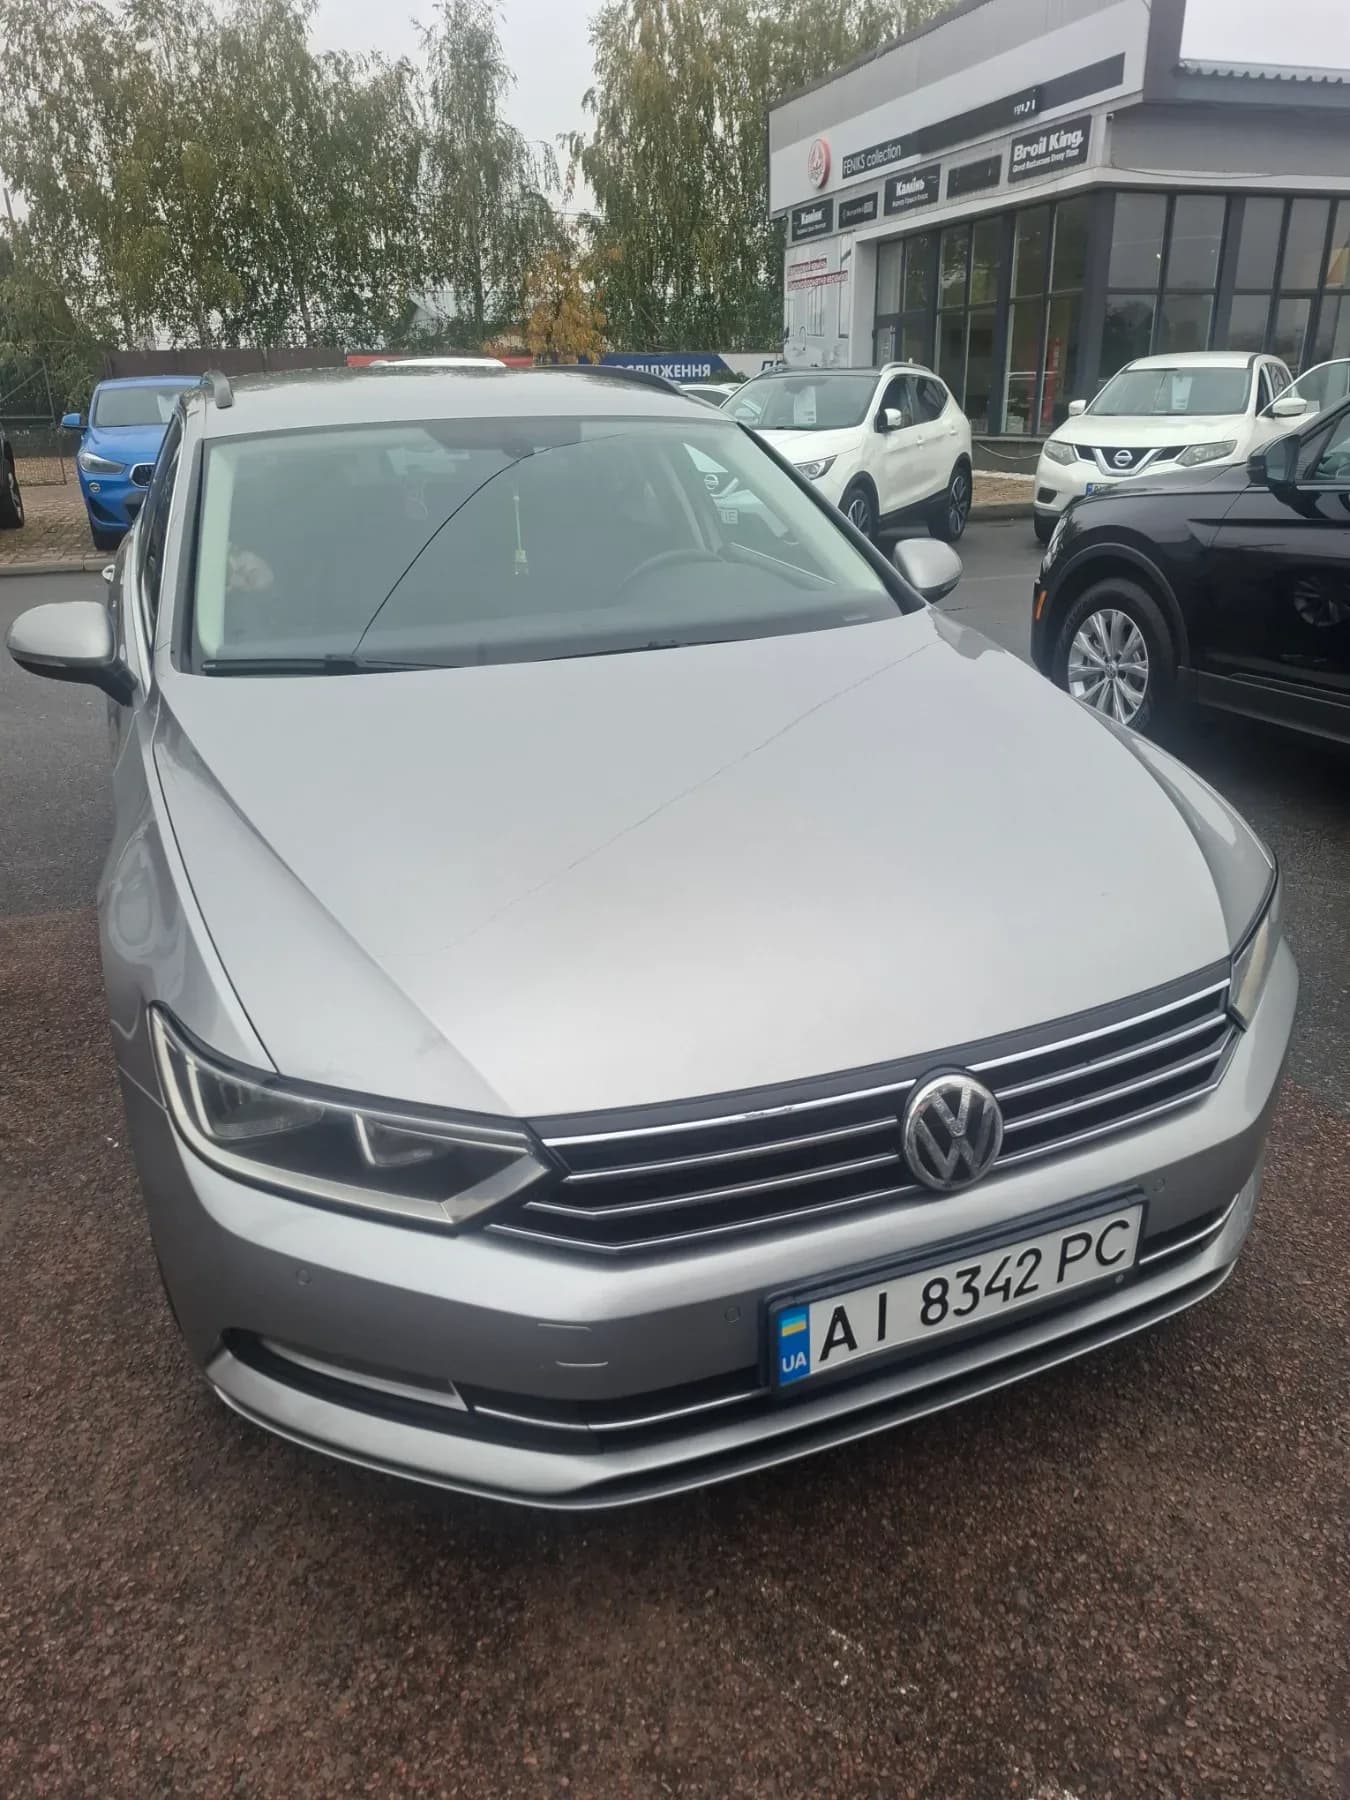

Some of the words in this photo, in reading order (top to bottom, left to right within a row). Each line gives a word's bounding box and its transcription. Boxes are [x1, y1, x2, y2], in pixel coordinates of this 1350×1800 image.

[866, 144, 902, 167] collection
[1013, 136, 1047, 161] Broil
[818, 1292, 888, 1362] AI
[919, 1247, 1042, 1326] 8342
[1056, 1219, 1131, 1284] PC
[781, 1354, 807, 1373] UA
